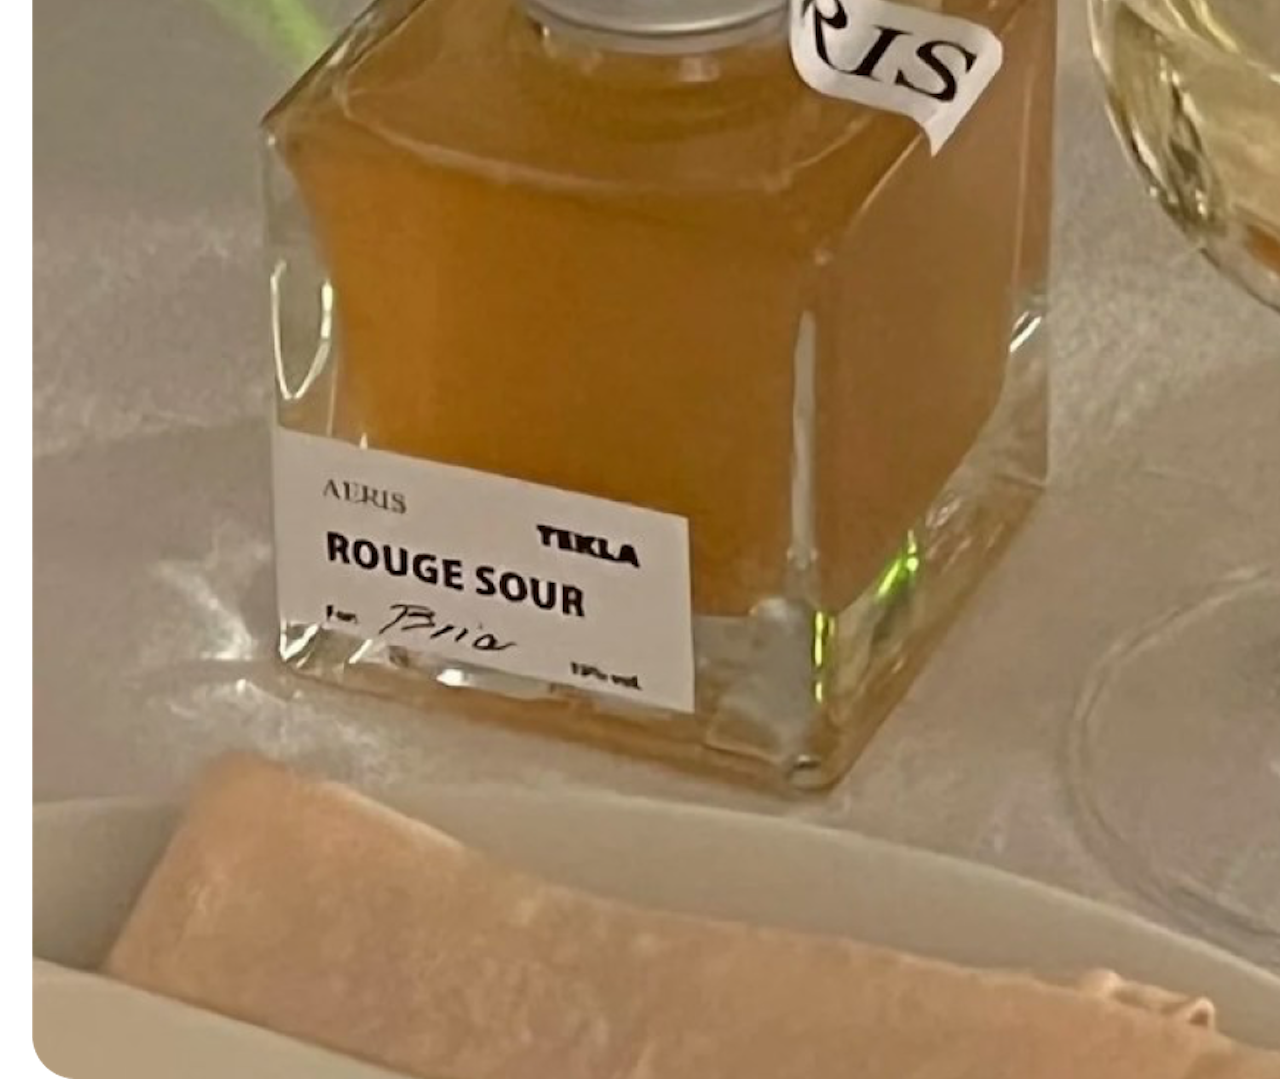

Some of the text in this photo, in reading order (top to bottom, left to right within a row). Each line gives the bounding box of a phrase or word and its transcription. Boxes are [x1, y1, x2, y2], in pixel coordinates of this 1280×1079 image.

[323, 479, 408, 515] AERIS
[536, 524, 641, 568] TEKLA
[327, 531, 586, 617] ROUGE SOUR
